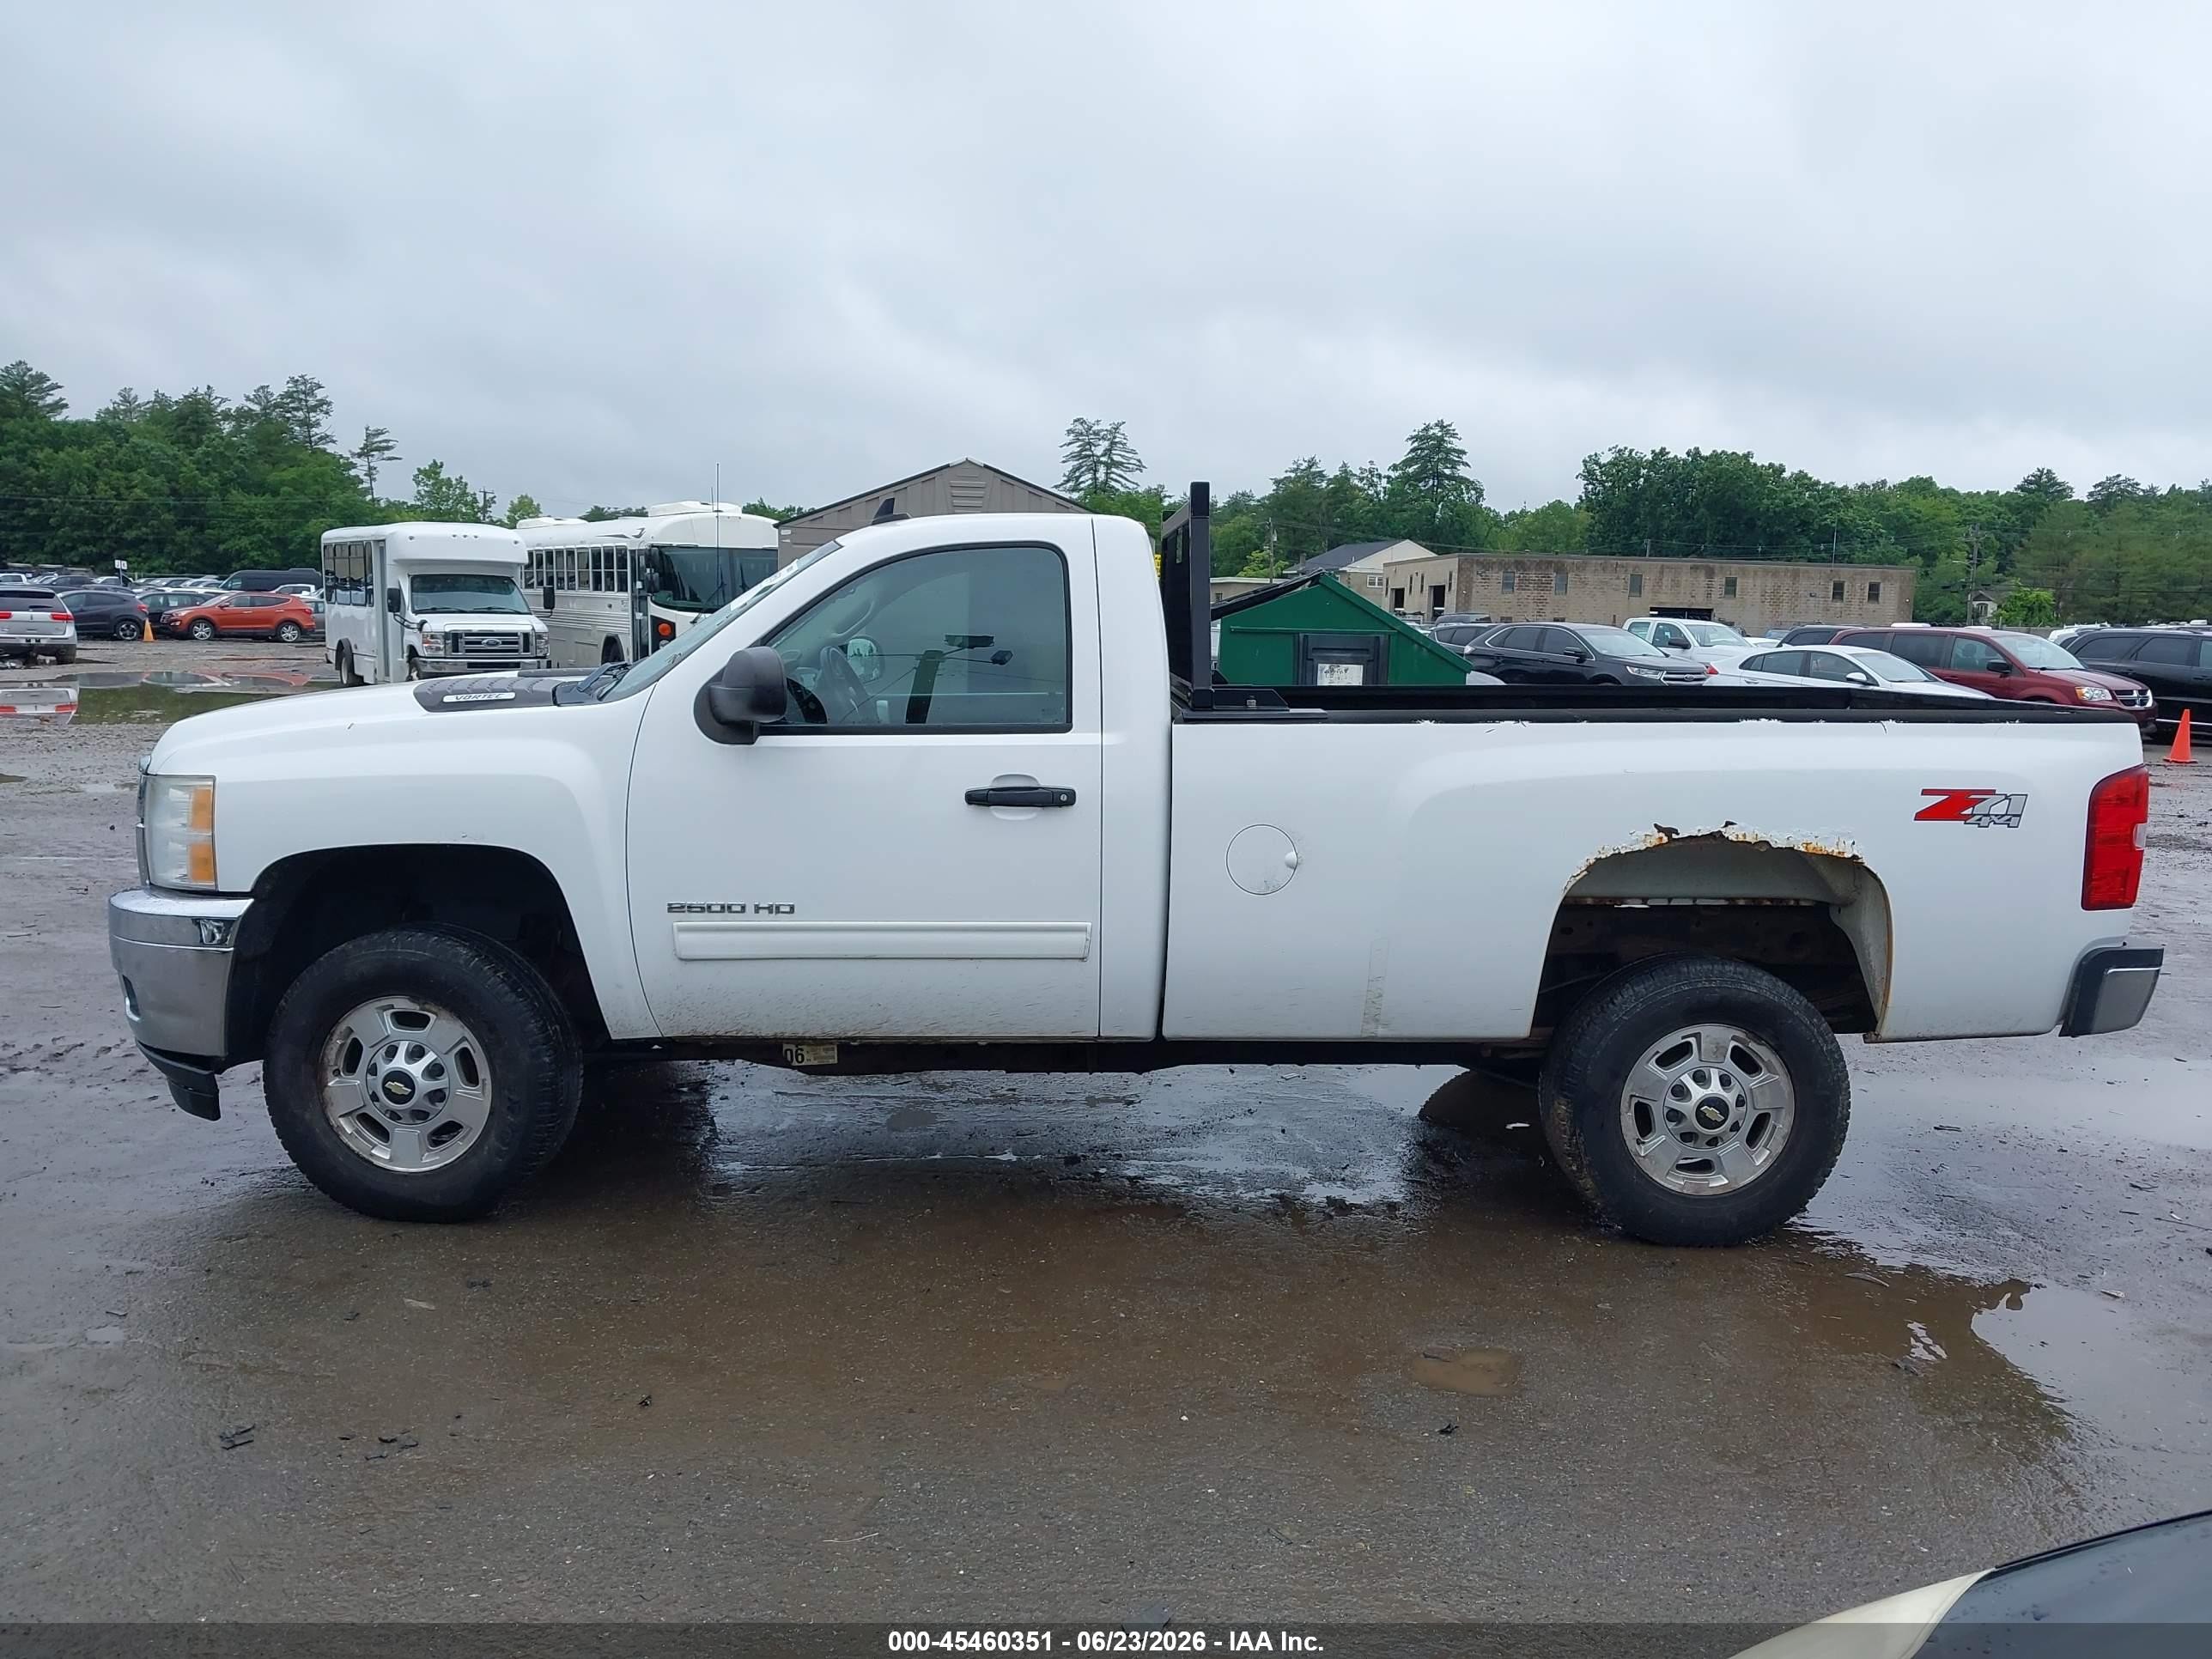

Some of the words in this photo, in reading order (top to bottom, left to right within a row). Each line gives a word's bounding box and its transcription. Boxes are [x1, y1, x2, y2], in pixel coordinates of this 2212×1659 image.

[1914, 788, 2028, 821] Z71
[666, 902, 746, 914] 2500
[753, 902, 795, 915] HD
